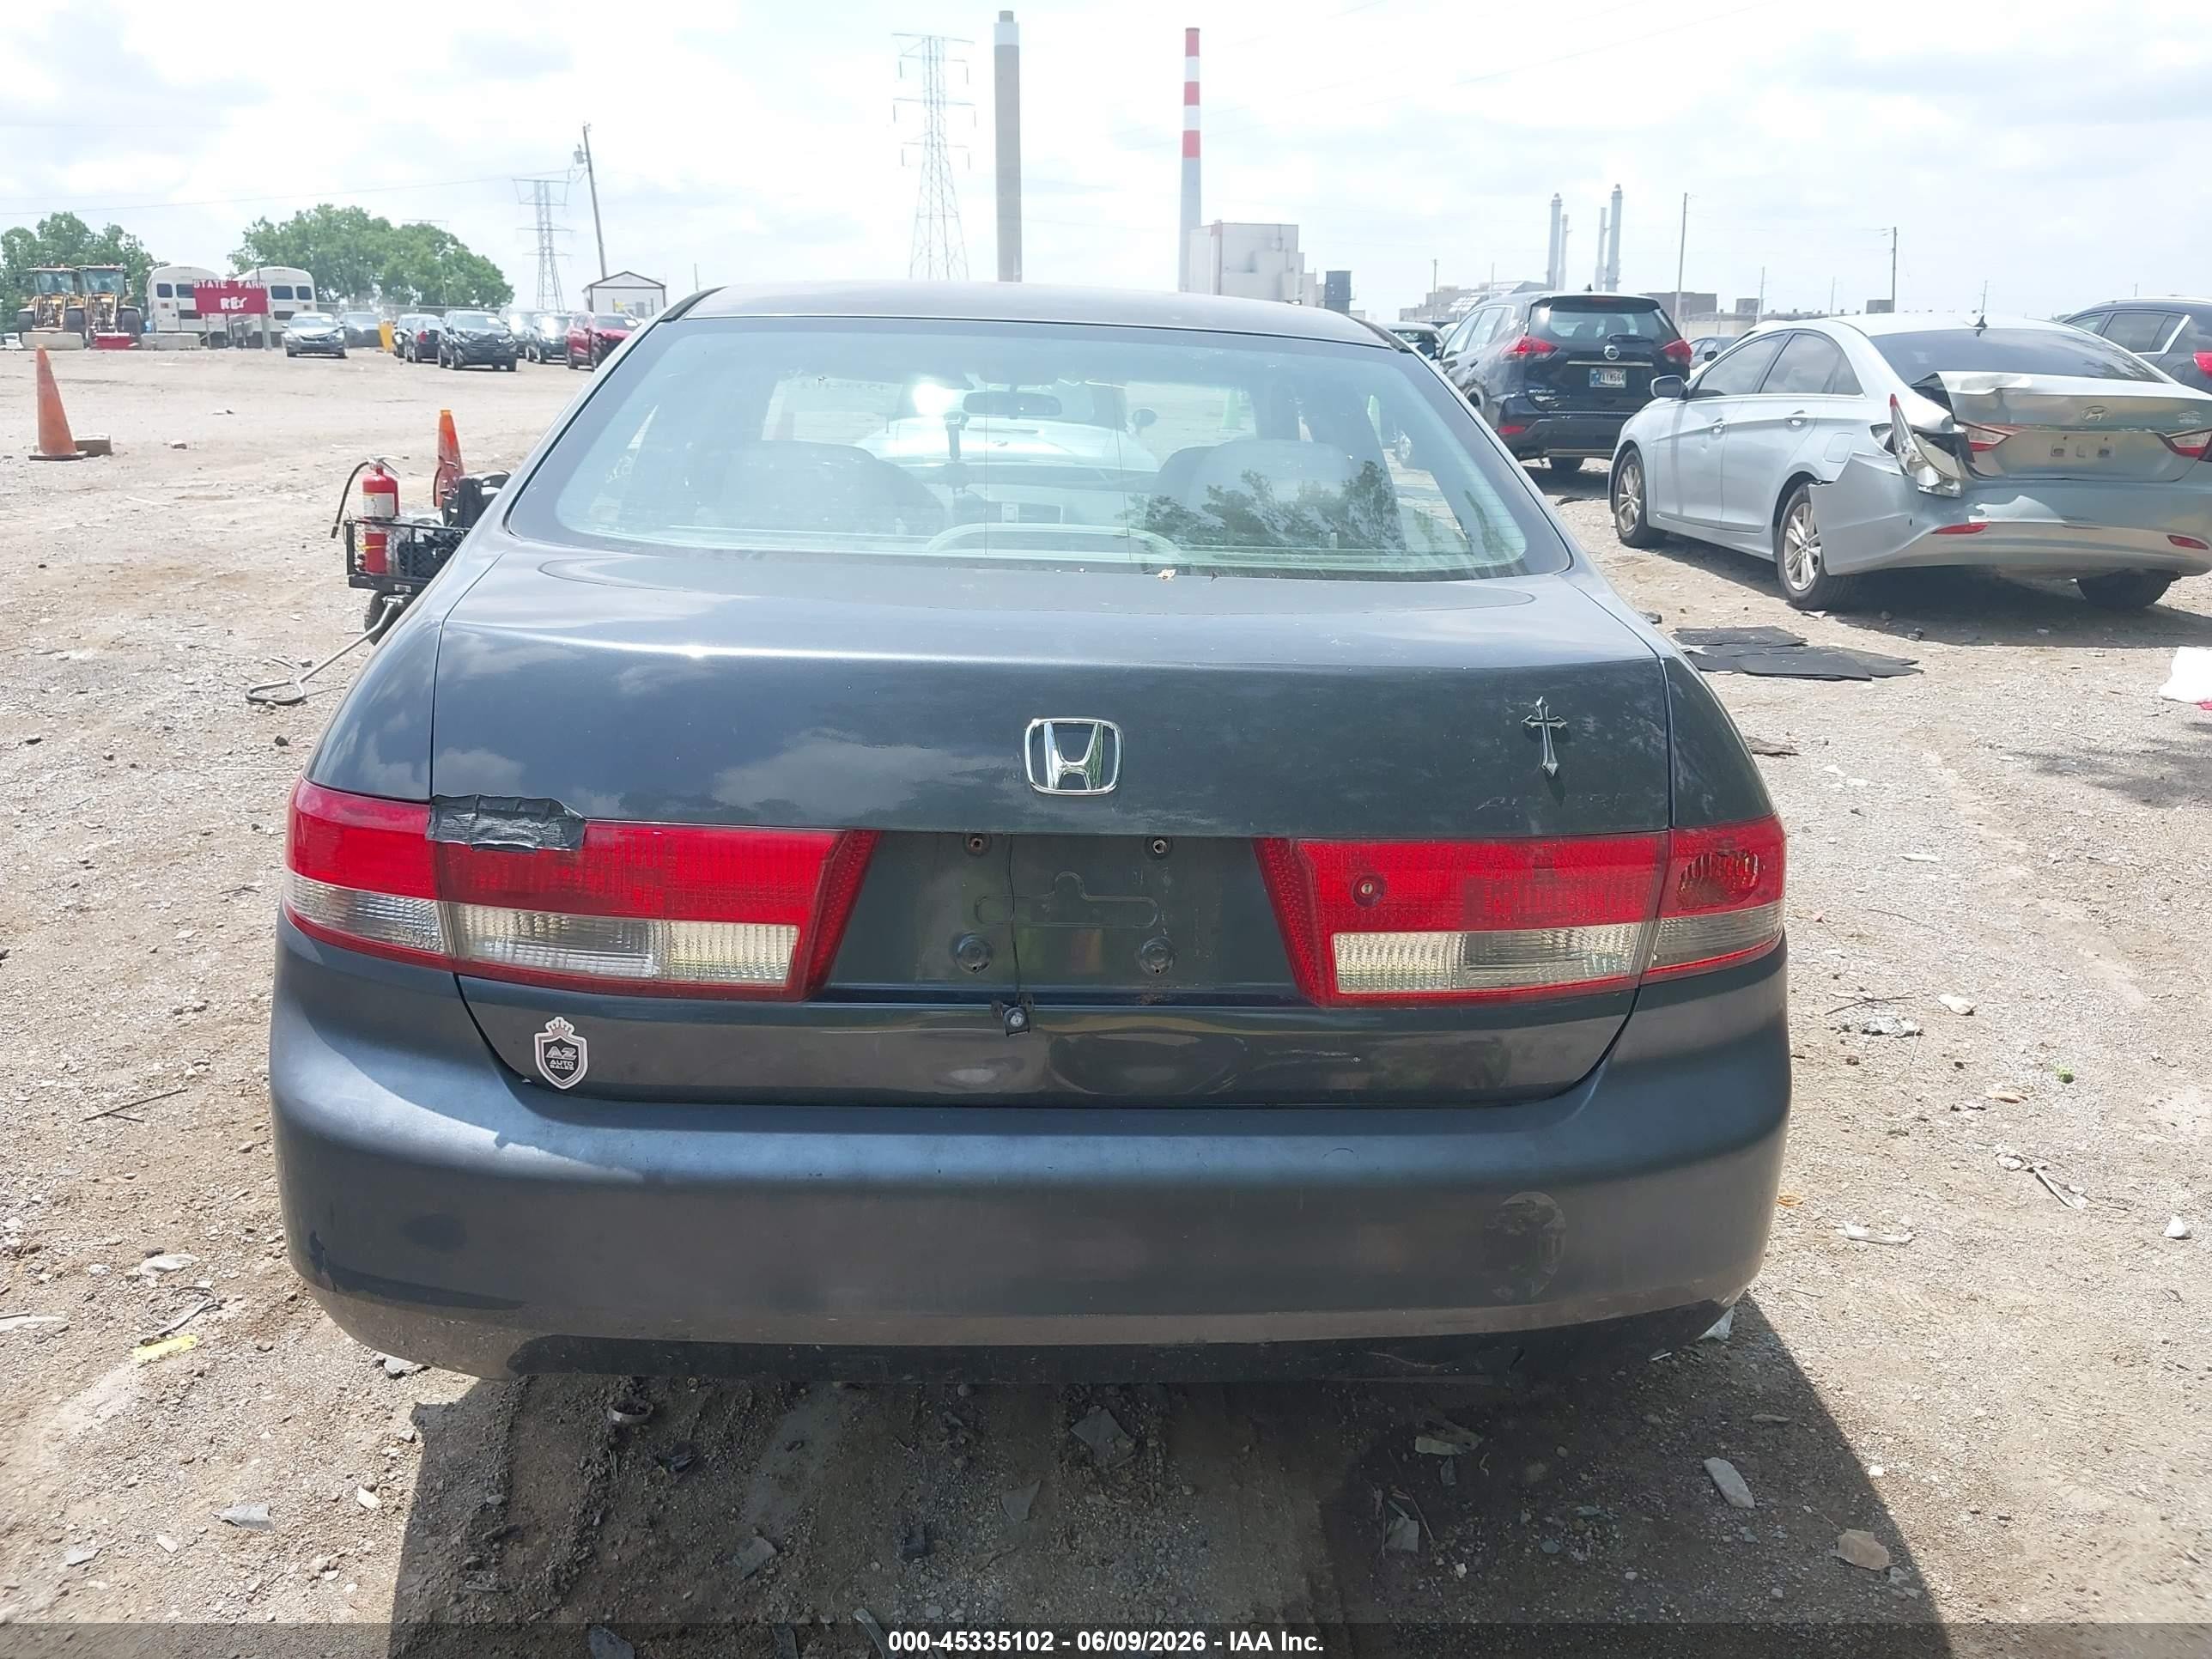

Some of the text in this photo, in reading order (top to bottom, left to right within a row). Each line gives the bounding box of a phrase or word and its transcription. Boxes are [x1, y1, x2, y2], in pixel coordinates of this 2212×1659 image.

[193, 280, 266, 289] STATE FARM
[545, 1046, 577, 1060] AZ
